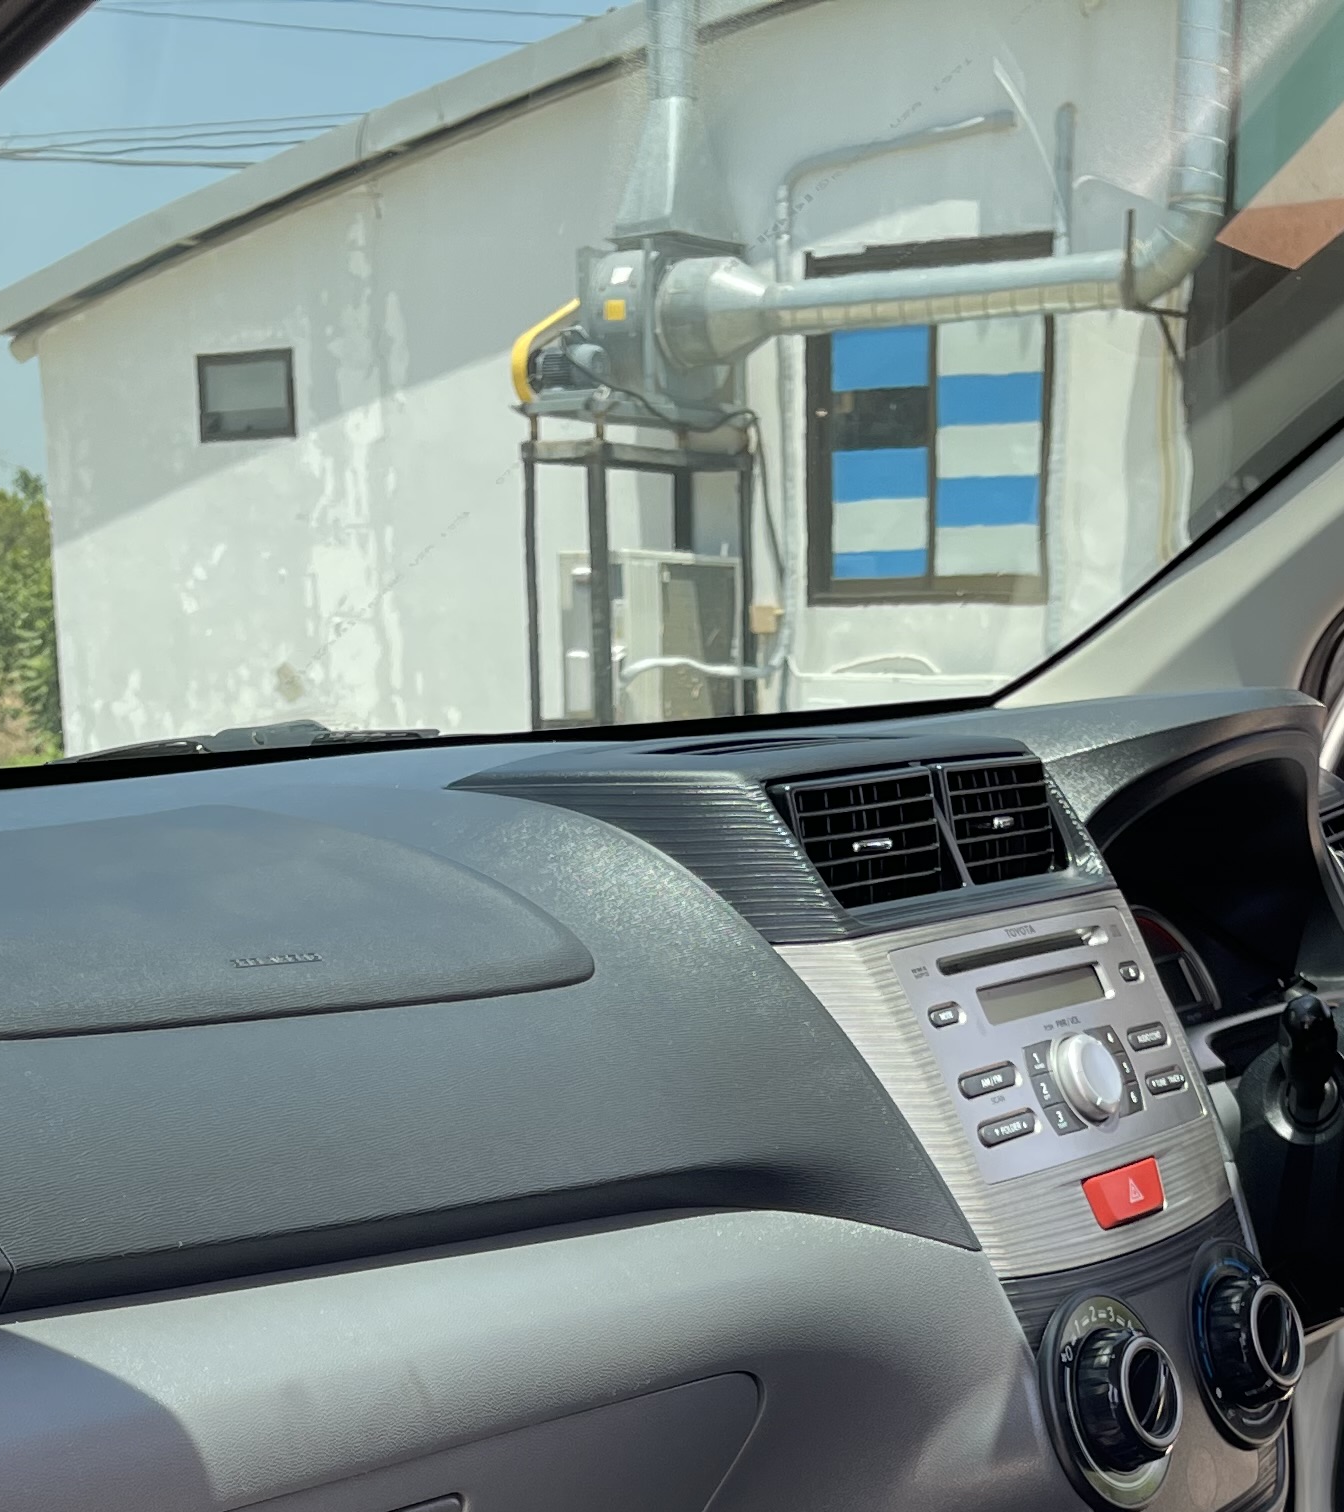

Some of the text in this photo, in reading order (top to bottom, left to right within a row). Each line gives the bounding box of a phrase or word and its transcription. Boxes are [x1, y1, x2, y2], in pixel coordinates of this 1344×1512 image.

[1005, 925, 1036, 938] TOYOTA
[1032, 1052, 1040, 1063] 1
[1040, 1082, 1048, 1095] 2
[1056, 1110, 1064, 1122] 3
[1088, 1305, 1097, 1322] 2
[1106, 1306, 1115, 1322] 3
